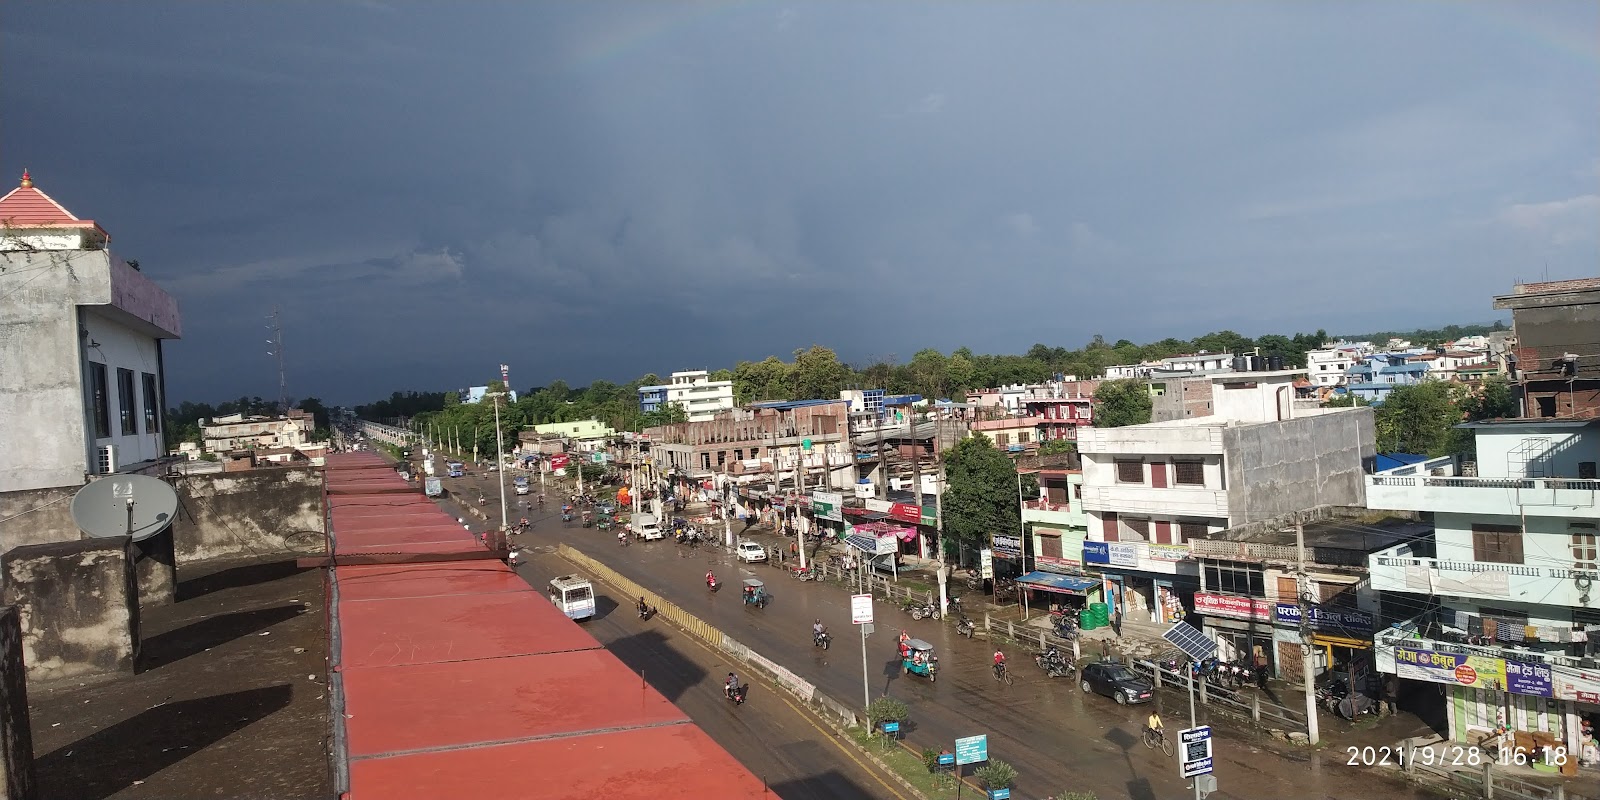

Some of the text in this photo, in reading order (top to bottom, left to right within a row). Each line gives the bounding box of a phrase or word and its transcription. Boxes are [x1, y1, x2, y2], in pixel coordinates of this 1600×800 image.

[1396, 648, 1456, 669] मेगा केबुल
[1506, 662, 1521, 675] मेगा
[1522, 664, 1533, 678] ट्रेड
